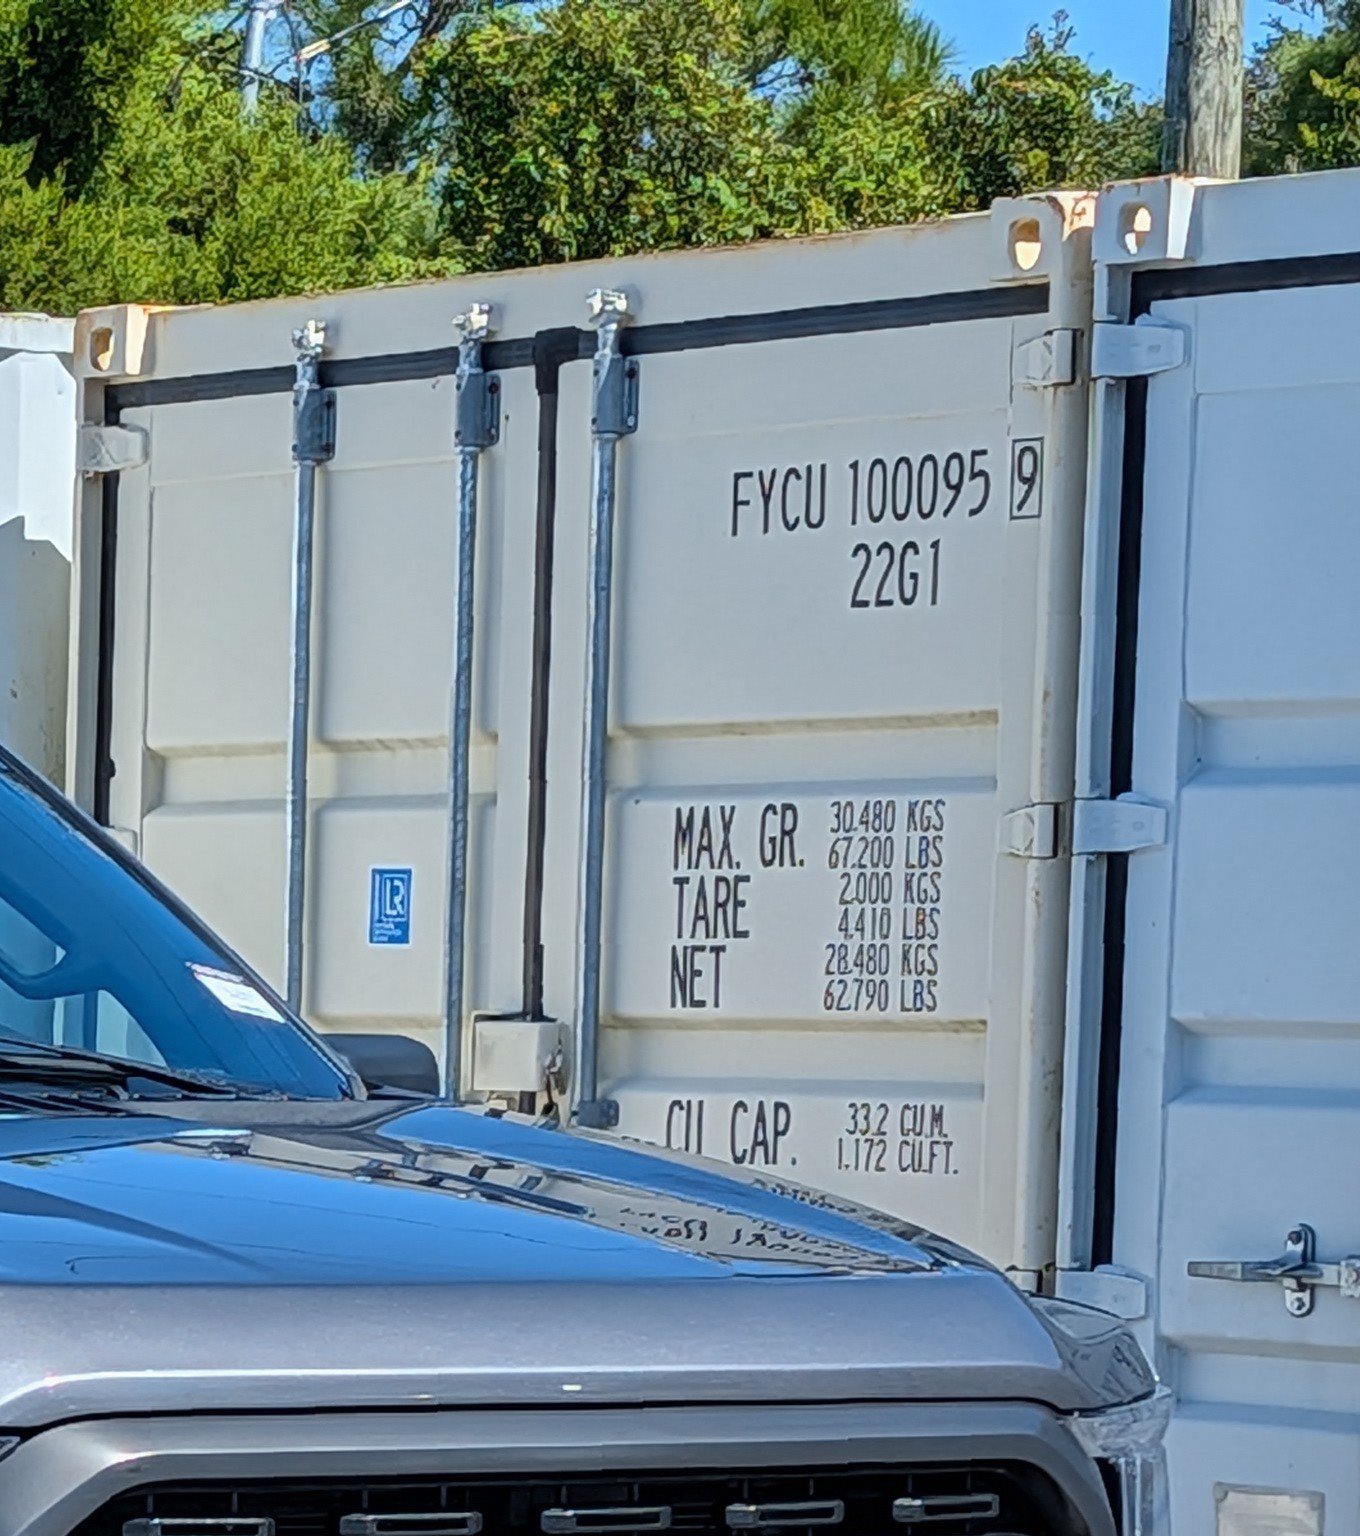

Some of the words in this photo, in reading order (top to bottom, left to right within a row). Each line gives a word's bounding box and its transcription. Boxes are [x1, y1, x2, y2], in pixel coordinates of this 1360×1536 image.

[731, 463, 828, 537] FYCU
[848, 448, 992, 527] 100095
[1016, 444, 1039, 513] 9
[849, 537, 942, 609] 22G1
[906, 798, 946, 833] KGS
[673, 804, 741, 871] MAX.
[759, 803, 806, 868] GR.
[904, 835, 943, 869] LBS
[903, 871, 941, 905] KGS
[673, 874, 751, 940] TARE
[902, 906, 940, 940] LBS
[670, 944, 727, 1009] NET
[901, 943, 939, 976] KGS
[900, 978, 938, 1012] LBS
[730, 1100, 797, 1166] CAP.
[838, 1138, 887, 1172] 1.172
